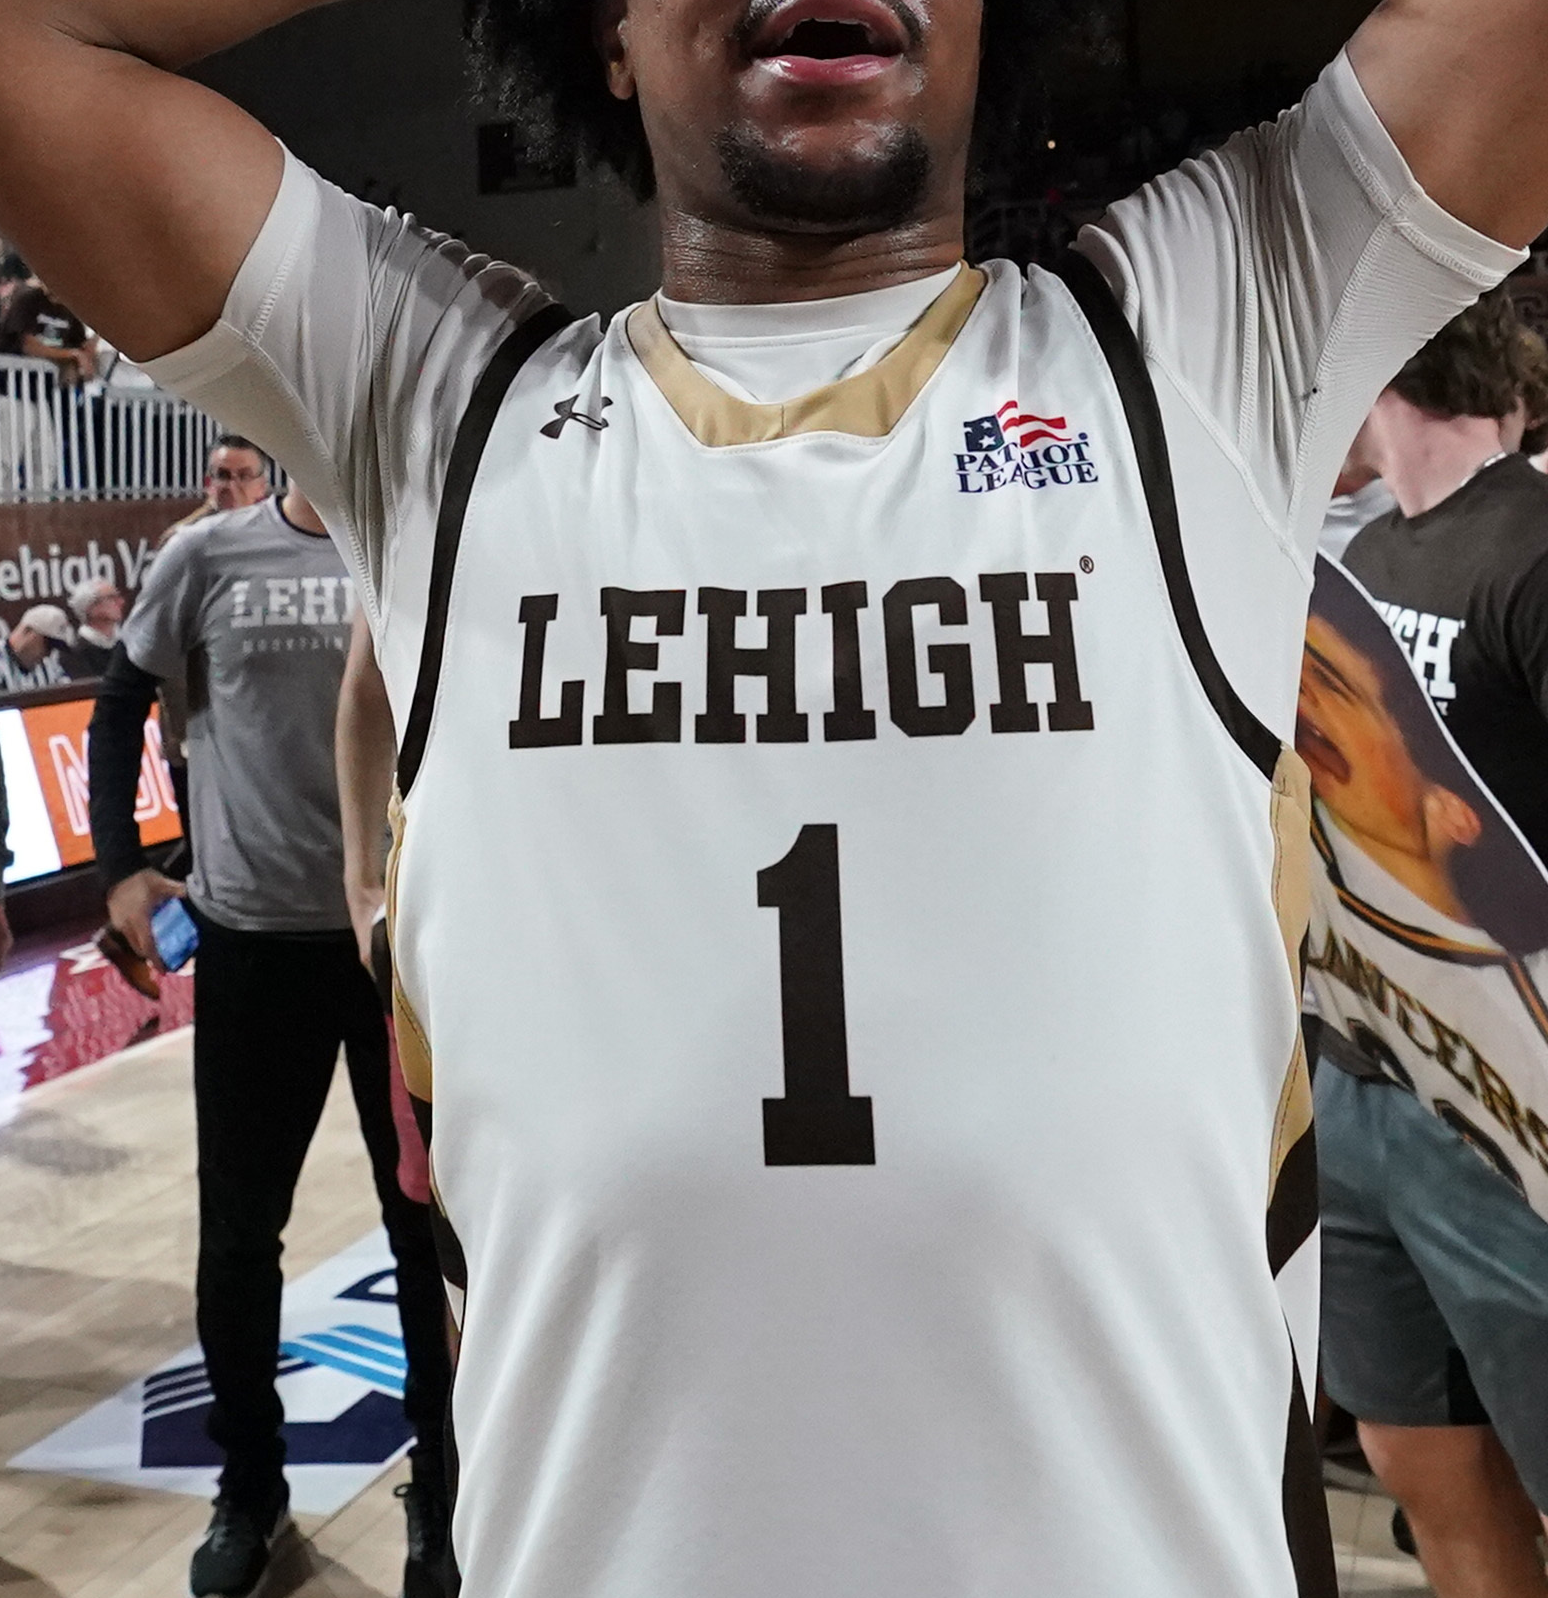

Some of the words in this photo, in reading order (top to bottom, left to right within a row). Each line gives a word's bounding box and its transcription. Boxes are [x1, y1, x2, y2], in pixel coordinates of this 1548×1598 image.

[956, 462, 1099, 494] LEAGUE
[230, 576, 356, 629] LEHI
[508, 571, 1095, 750] LEHIGH
[756, 822, 877, 1167] 1
